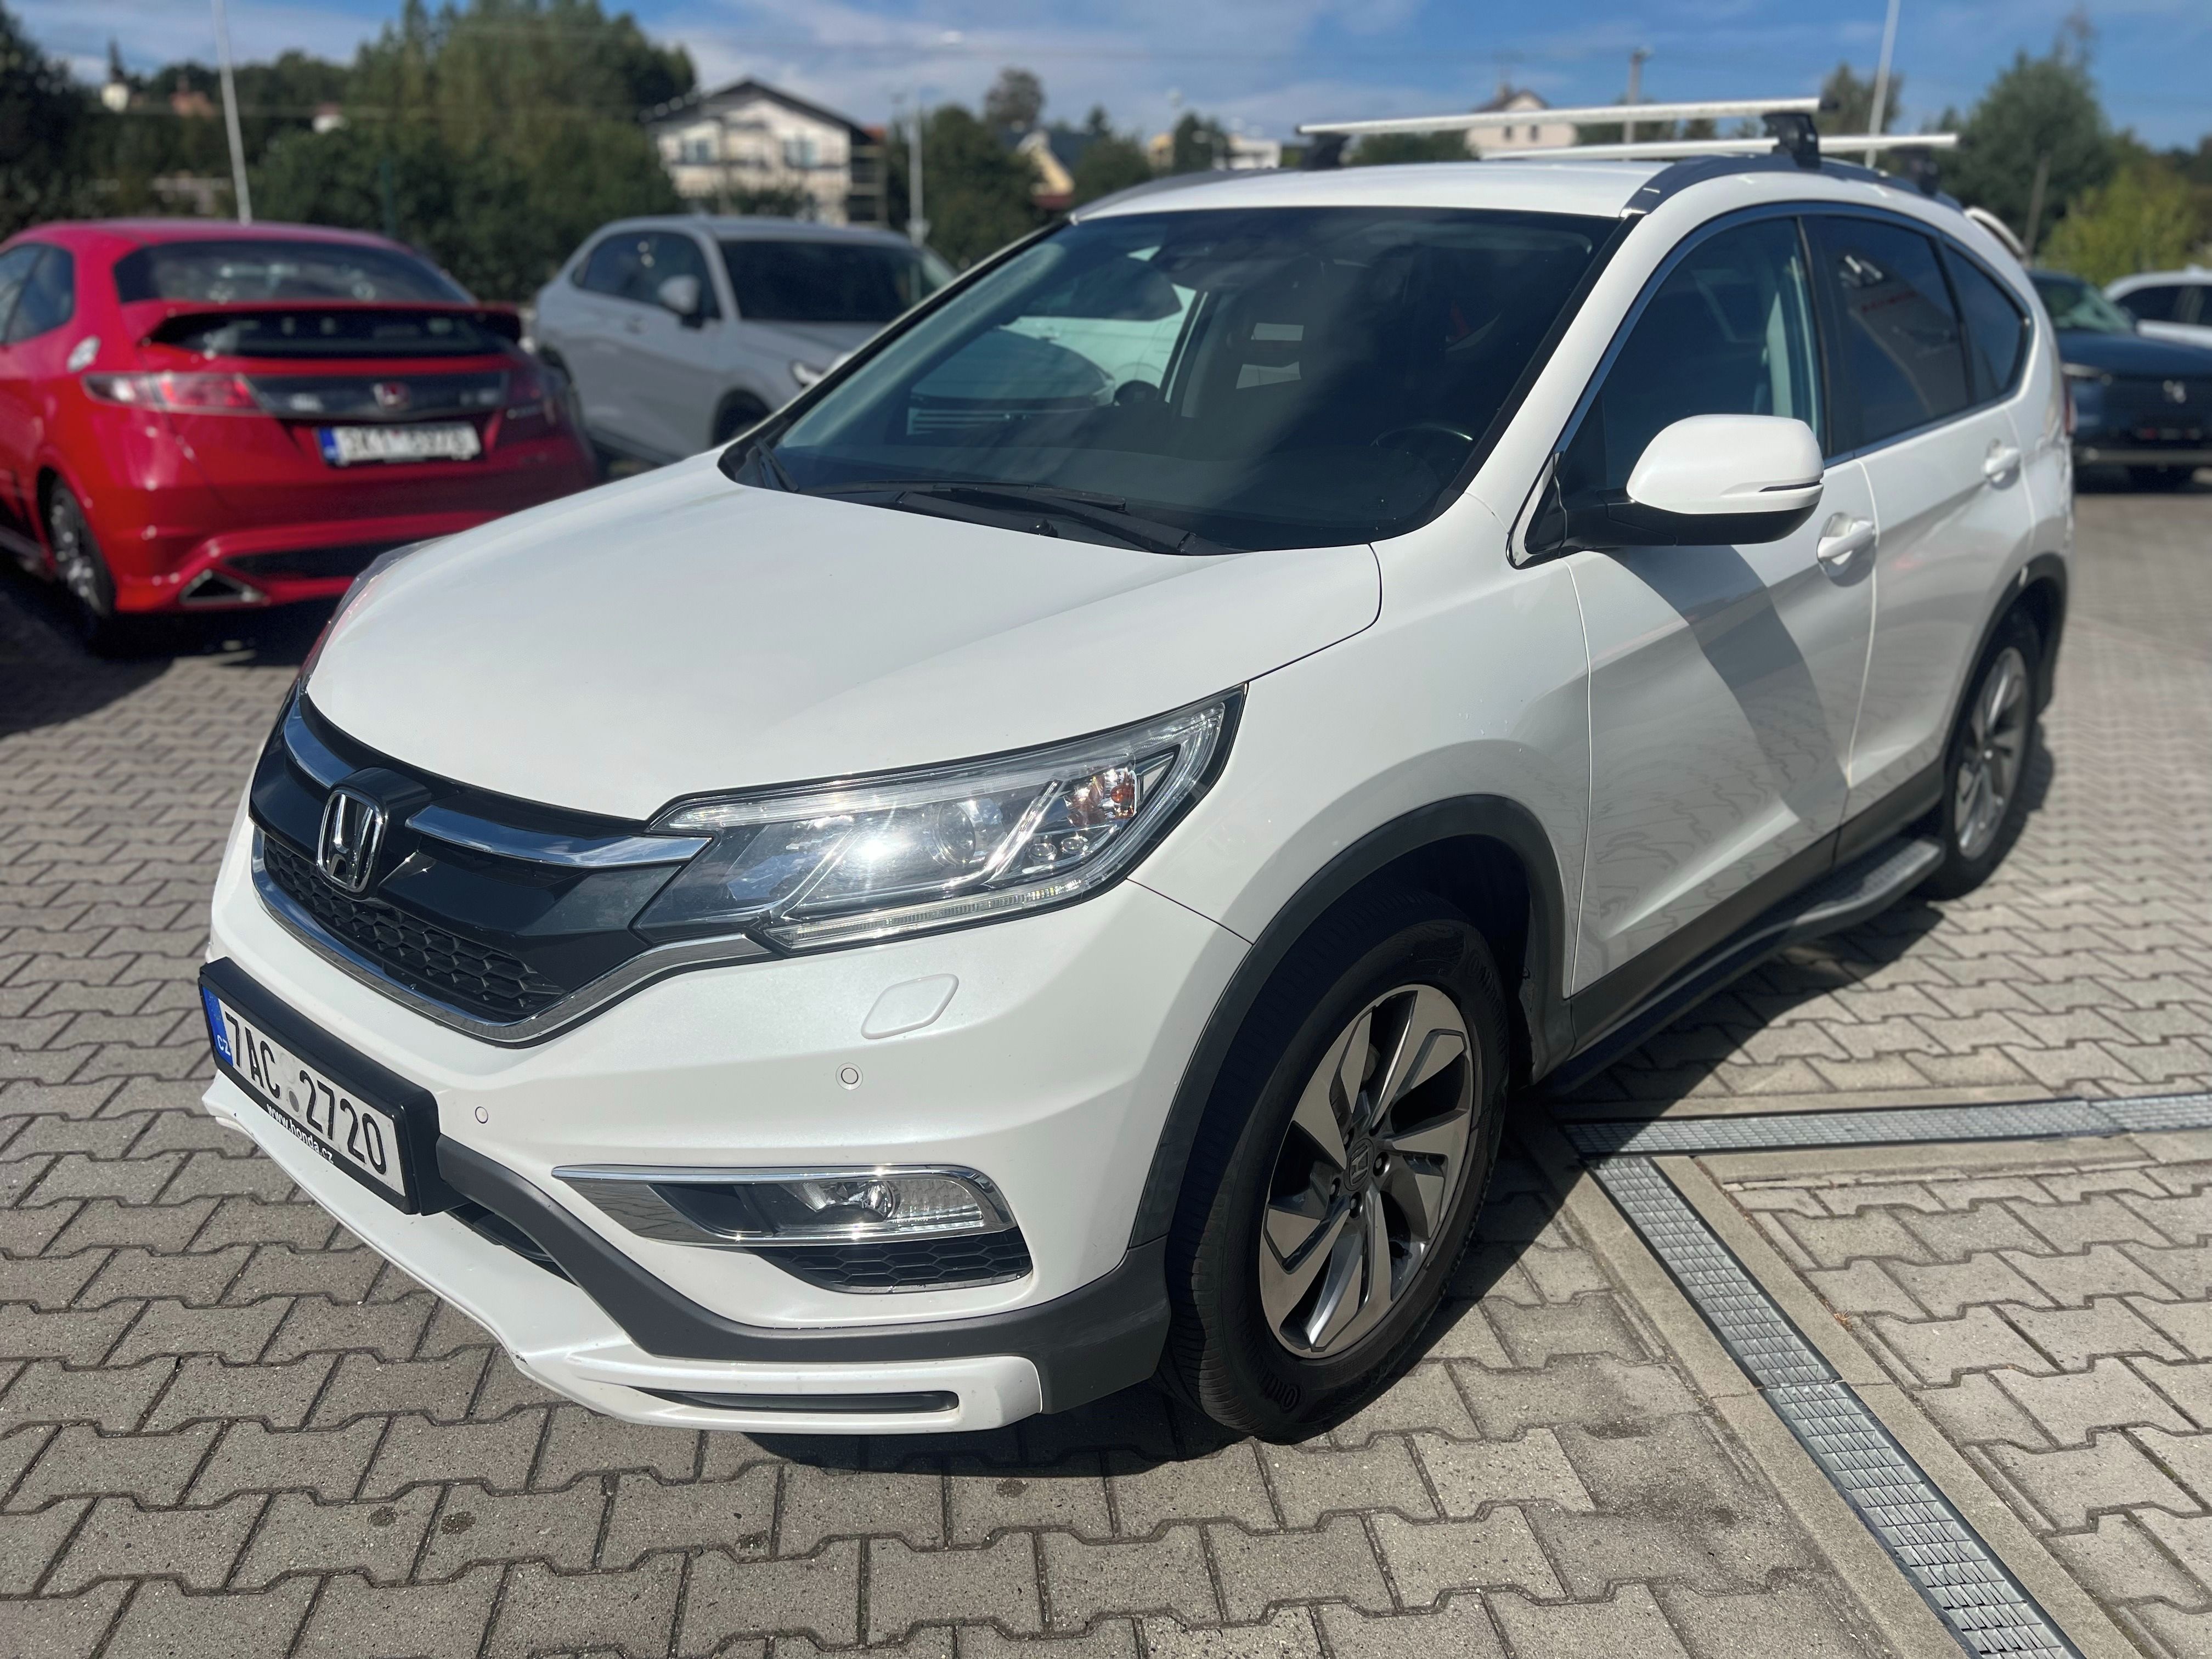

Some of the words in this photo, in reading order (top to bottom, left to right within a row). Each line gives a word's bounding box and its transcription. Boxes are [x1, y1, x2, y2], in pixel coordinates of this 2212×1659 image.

[217, 1034, 231, 1056] CZ
[225, 1011, 280, 1099] 7AC
[300, 1070, 386, 1175] 2720
[267, 1103, 334, 1164] www.honda.cz
